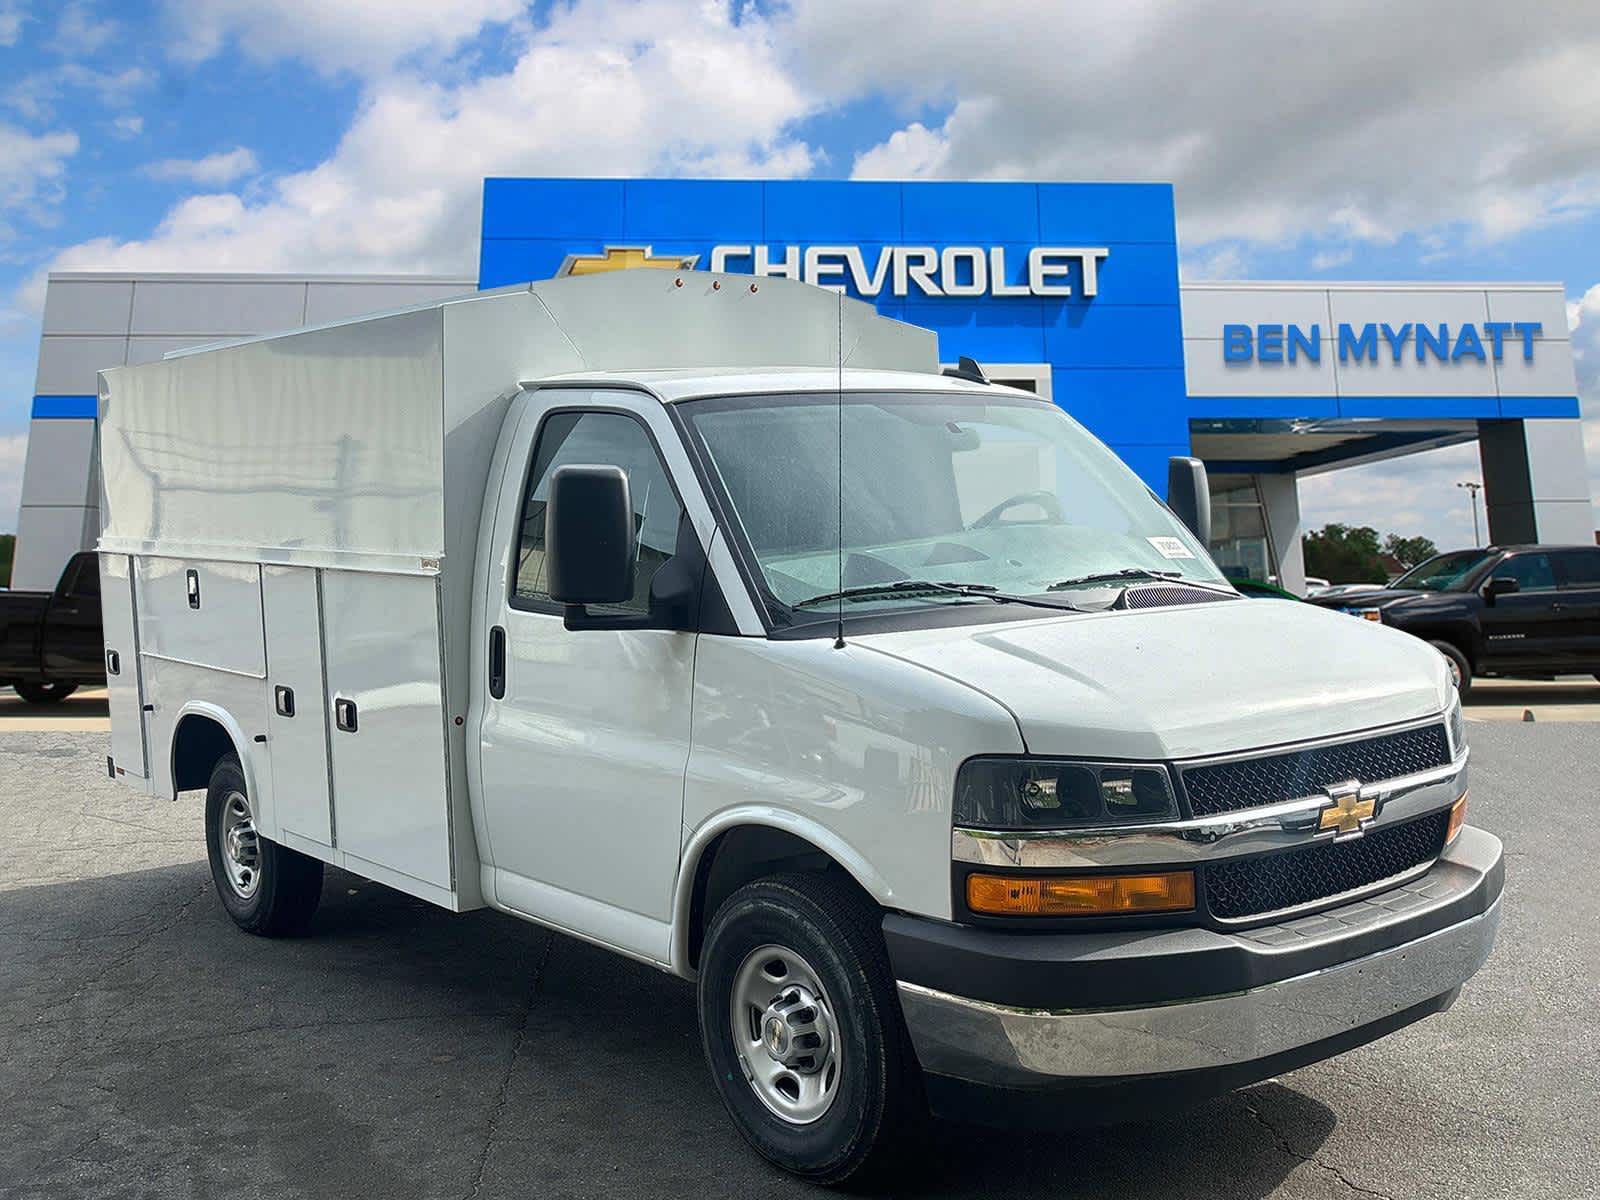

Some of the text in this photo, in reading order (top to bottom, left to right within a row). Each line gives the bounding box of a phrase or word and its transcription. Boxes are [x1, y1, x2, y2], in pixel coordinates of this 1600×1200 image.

[711, 245, 1109, 296] CHEVROLET
[1223, 322, 1542, 362] BEN MYNATT
